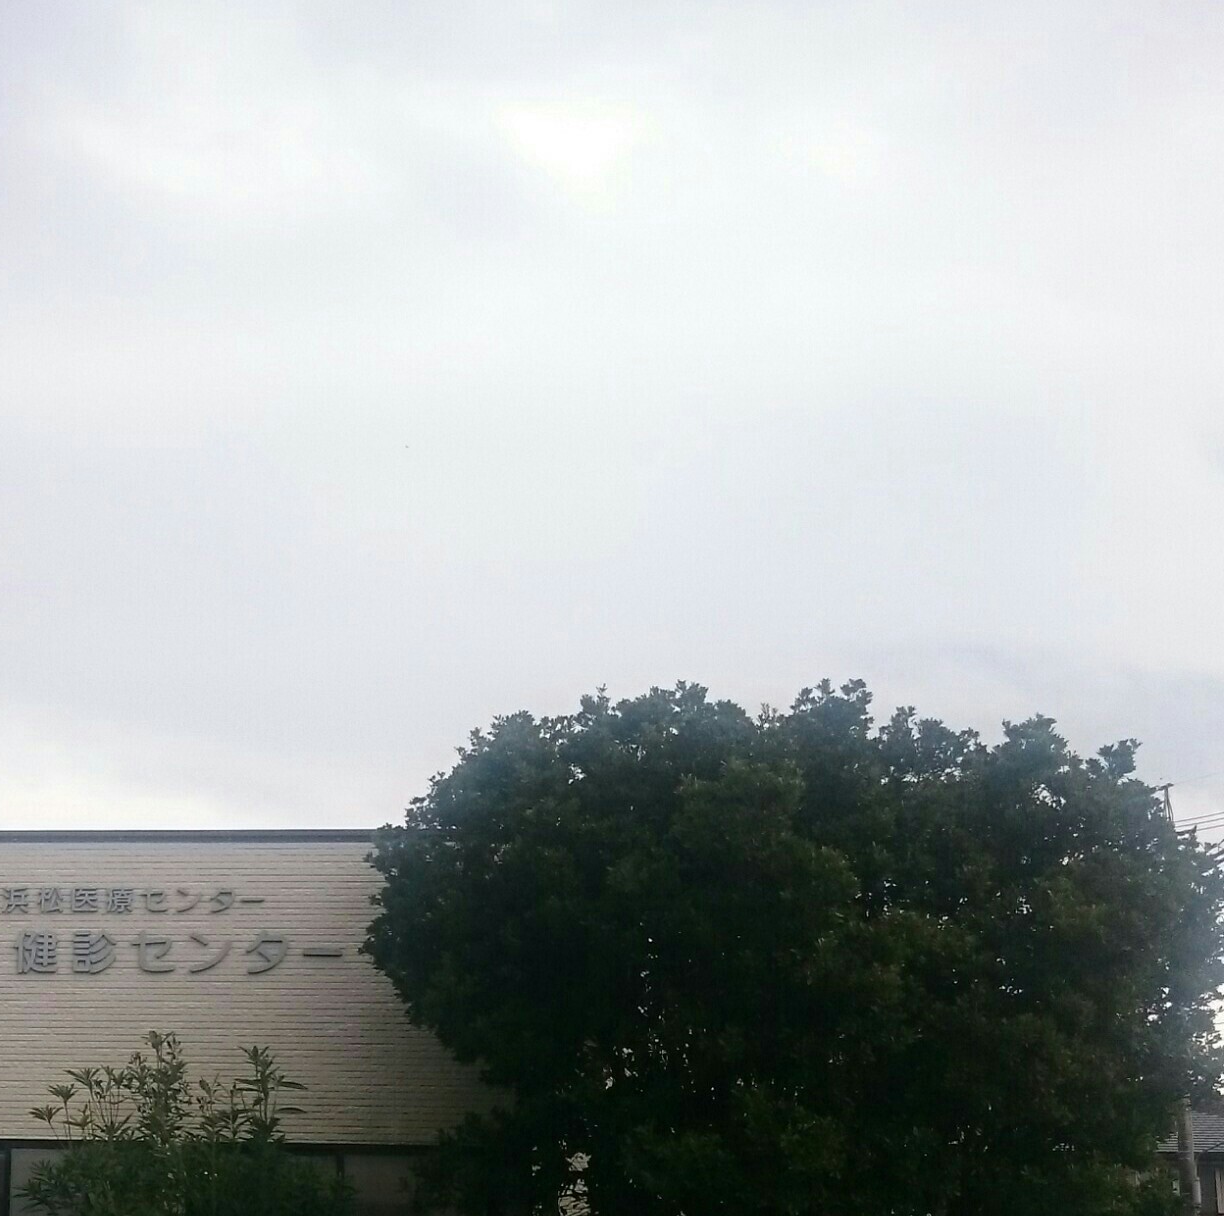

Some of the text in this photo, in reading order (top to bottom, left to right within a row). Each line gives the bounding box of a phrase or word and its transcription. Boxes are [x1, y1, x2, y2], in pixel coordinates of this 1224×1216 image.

[1, 887, 266, 915] 浜松医療センター
[13, 930, 344, 975] 健診センター
